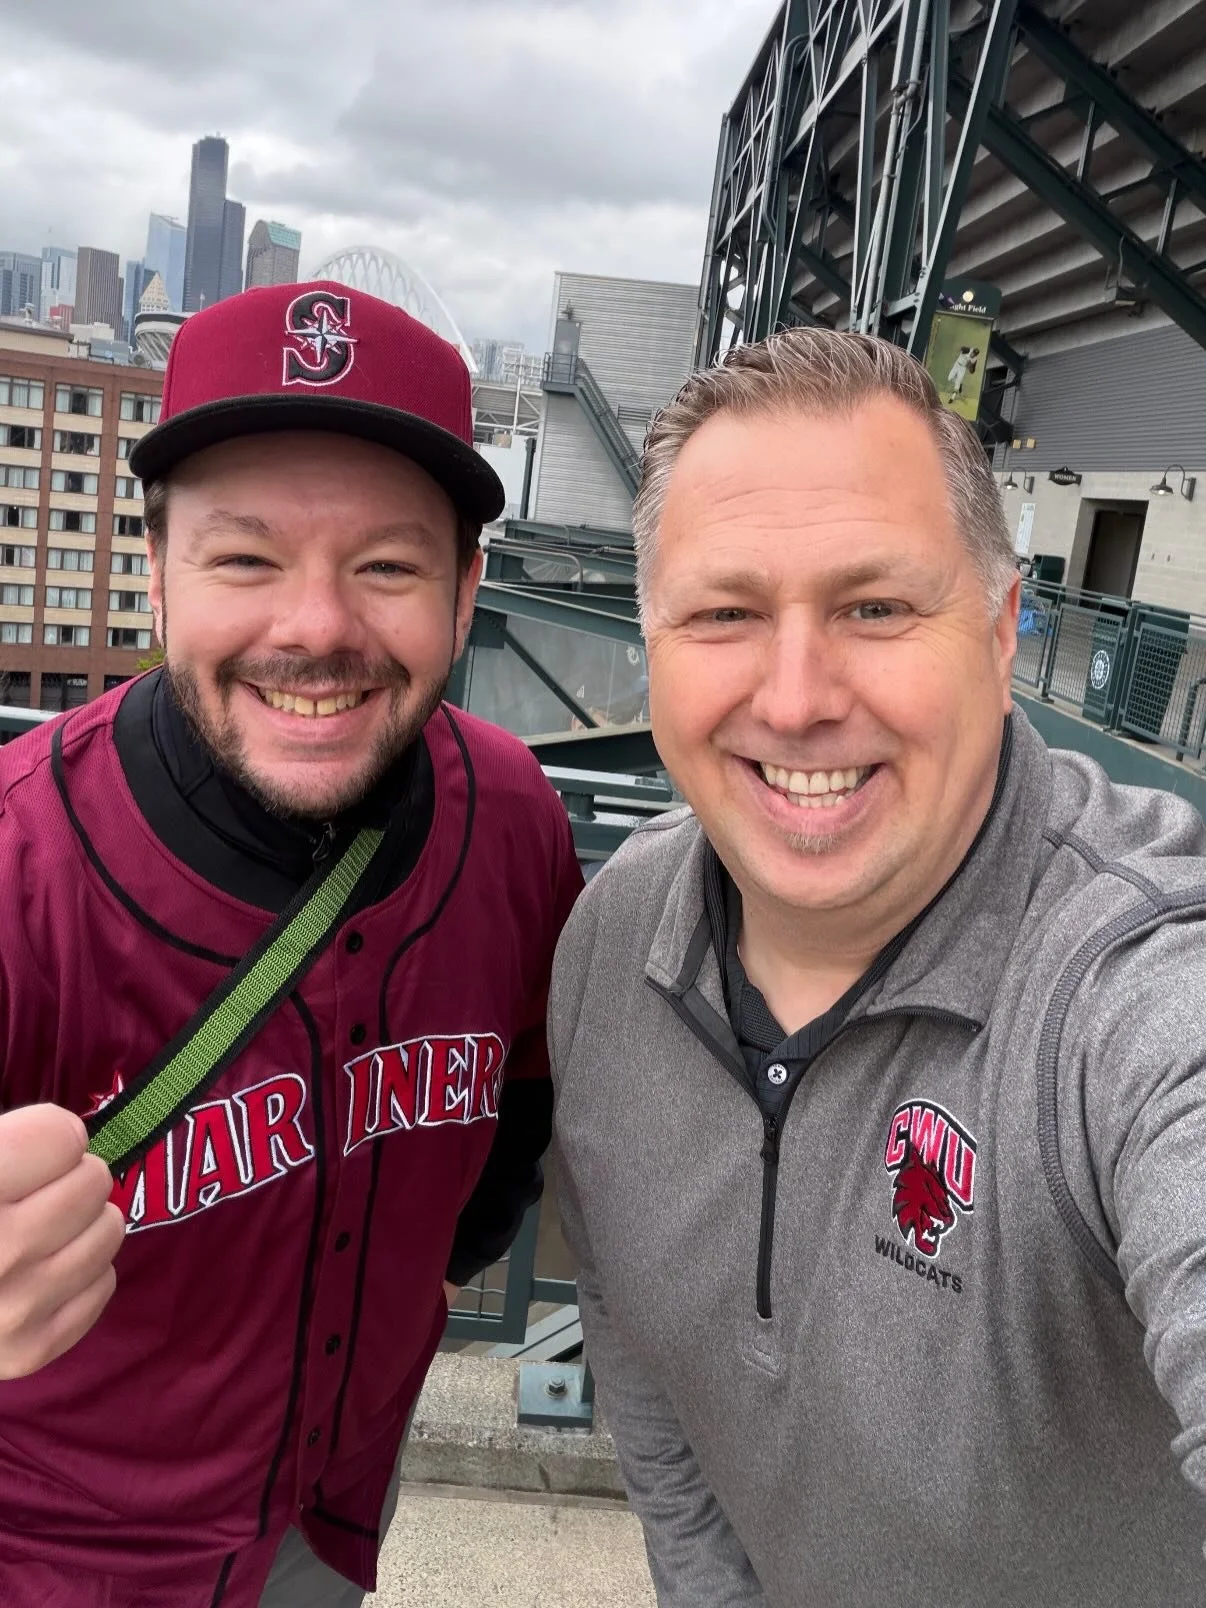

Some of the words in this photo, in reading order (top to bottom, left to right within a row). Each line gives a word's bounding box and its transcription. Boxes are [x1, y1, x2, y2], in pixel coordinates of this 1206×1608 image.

[283, 290, 355, 386] S
[949, 303, 966, 312] ight
[967, 304, 987, 314] Field
[1054, 473, 1077, 481] WOMEN
[885, 1101, 977, 1211] CWU
[874, 1234, 963, 1294] WILDCATS
